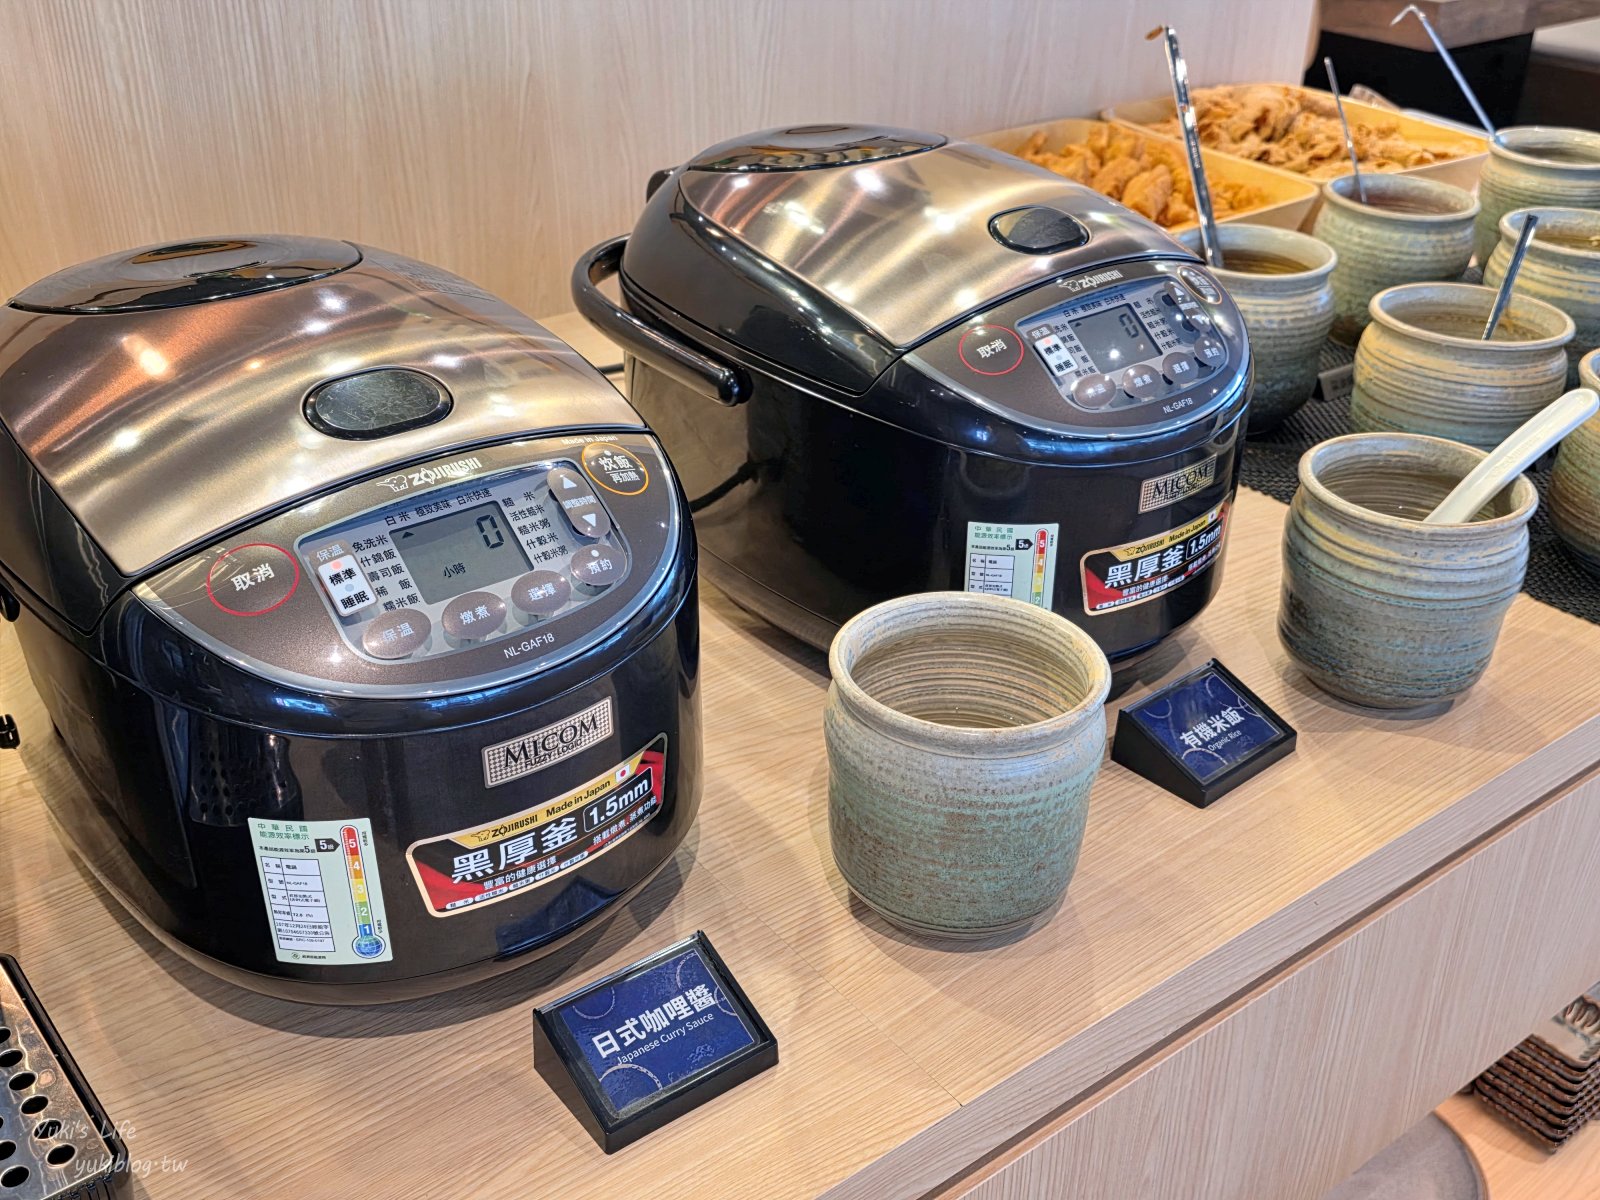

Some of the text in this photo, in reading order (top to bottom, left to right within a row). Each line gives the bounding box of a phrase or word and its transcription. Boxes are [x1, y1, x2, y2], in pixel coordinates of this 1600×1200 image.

[1078, 269, 1124, 288] ZOJIRUSHI
[1119, 312, 1139, 339] 0
[976, 338, 1007, 359] 取消
[1162, 397, 1194, 414] NL-GAF18
[408, 457, 483, 485] ZOJIRUSHI
[598, 455, 634, 471] 炊飯
[1152, 464, 1209, 500] MICOM
[384, 511, 411, 526] 白米
[455, 487, 493, 506] 白米快速
[508, 504, 545, 522] 活性糙米
[476, 514, 505, 550] 0
[316, 543, 345, 562] 保溫
[351, 534, 389, 553] 免洗米
[1039, 540, 1045, 548] 5
[359, 548, 397, 568] 什錦飯
[586, 558, 613, 575] 預約
[1104, 544, 1185, 589] 黑厚釜
[230, 562, 275, 592] 取消
[328, 567, 357, 587] 標準
[367, 563, 405, 583] 壽司飯
[442, 562, 467, 578] 小時
[340, 590, 370, 610] 睡眠
[382, 592, 421, 612] 糯米飯
[527, 582, 557, 601] 選擇
[459, 604, 491, 625] 燉煮
[382, 622, 415, 643] 保溫
[503, 633, 555, 659] NL-GAF18
[1179, 706, 1245, 749] 有機米飯
[504, 713, 599, 768] MICOM
[1207, 729, 1242, 753] Organic Rice
[525, 737, 584, 769] FUZZY LOGIC
[491, 780, 611, 839] ZOJIRUSHI Made in Japan
[589, 779, 649, 826] 1.5mm
[349, 838, 356, 848] 5
[451, 816, 578, 884] 黑厚釜
[353, 861, 360, 871] 4
[483, 855, 557, 891] 豐富的健康選擇
[357, 885, 363, 893] 3
[360, 907, 368, 916] 2
[363, 925, 370, 934] 1
[591, 983, 718, 1059] 日式咖哩醬
[616, 1012, 715, 1066] Japanese Curry Sauce
